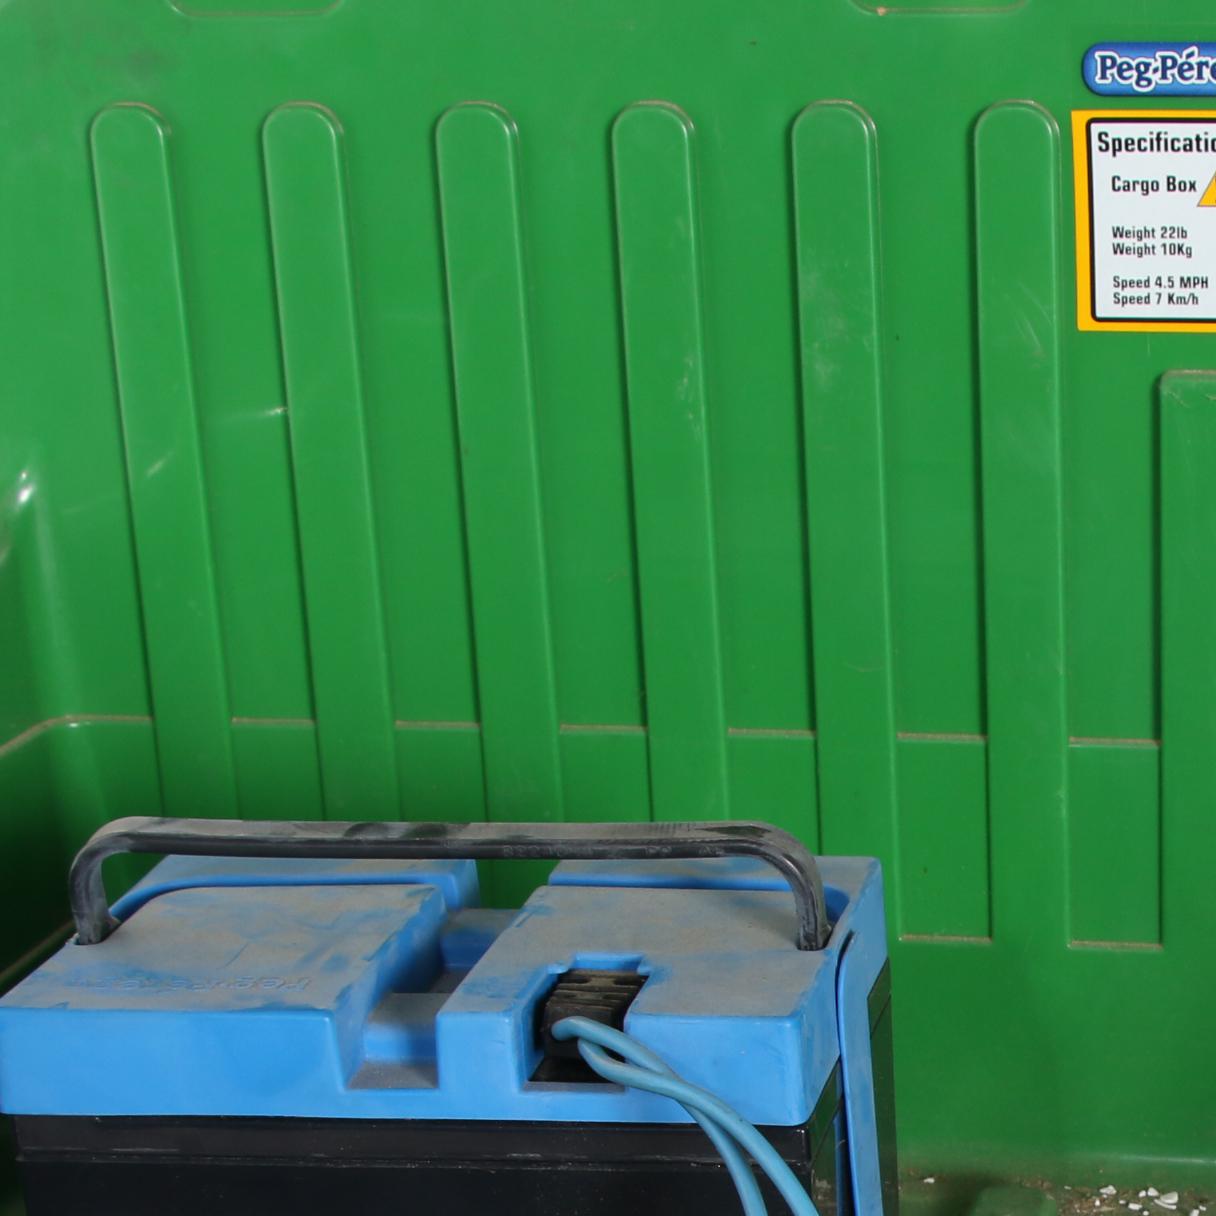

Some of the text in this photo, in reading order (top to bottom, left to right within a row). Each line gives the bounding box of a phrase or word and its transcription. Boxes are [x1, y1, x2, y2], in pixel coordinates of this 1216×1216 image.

[1111, 176, 1197, 196] Cargo Box
[1112, 226, 1188, 242] Weight 22lb
[1112, 243, 1193, 258] Weight 10Kg
[1113, 275, 1209, 291] Speed 4.5 MPH
[1113, 292, 1199, 307] Speed 7 Km/h
